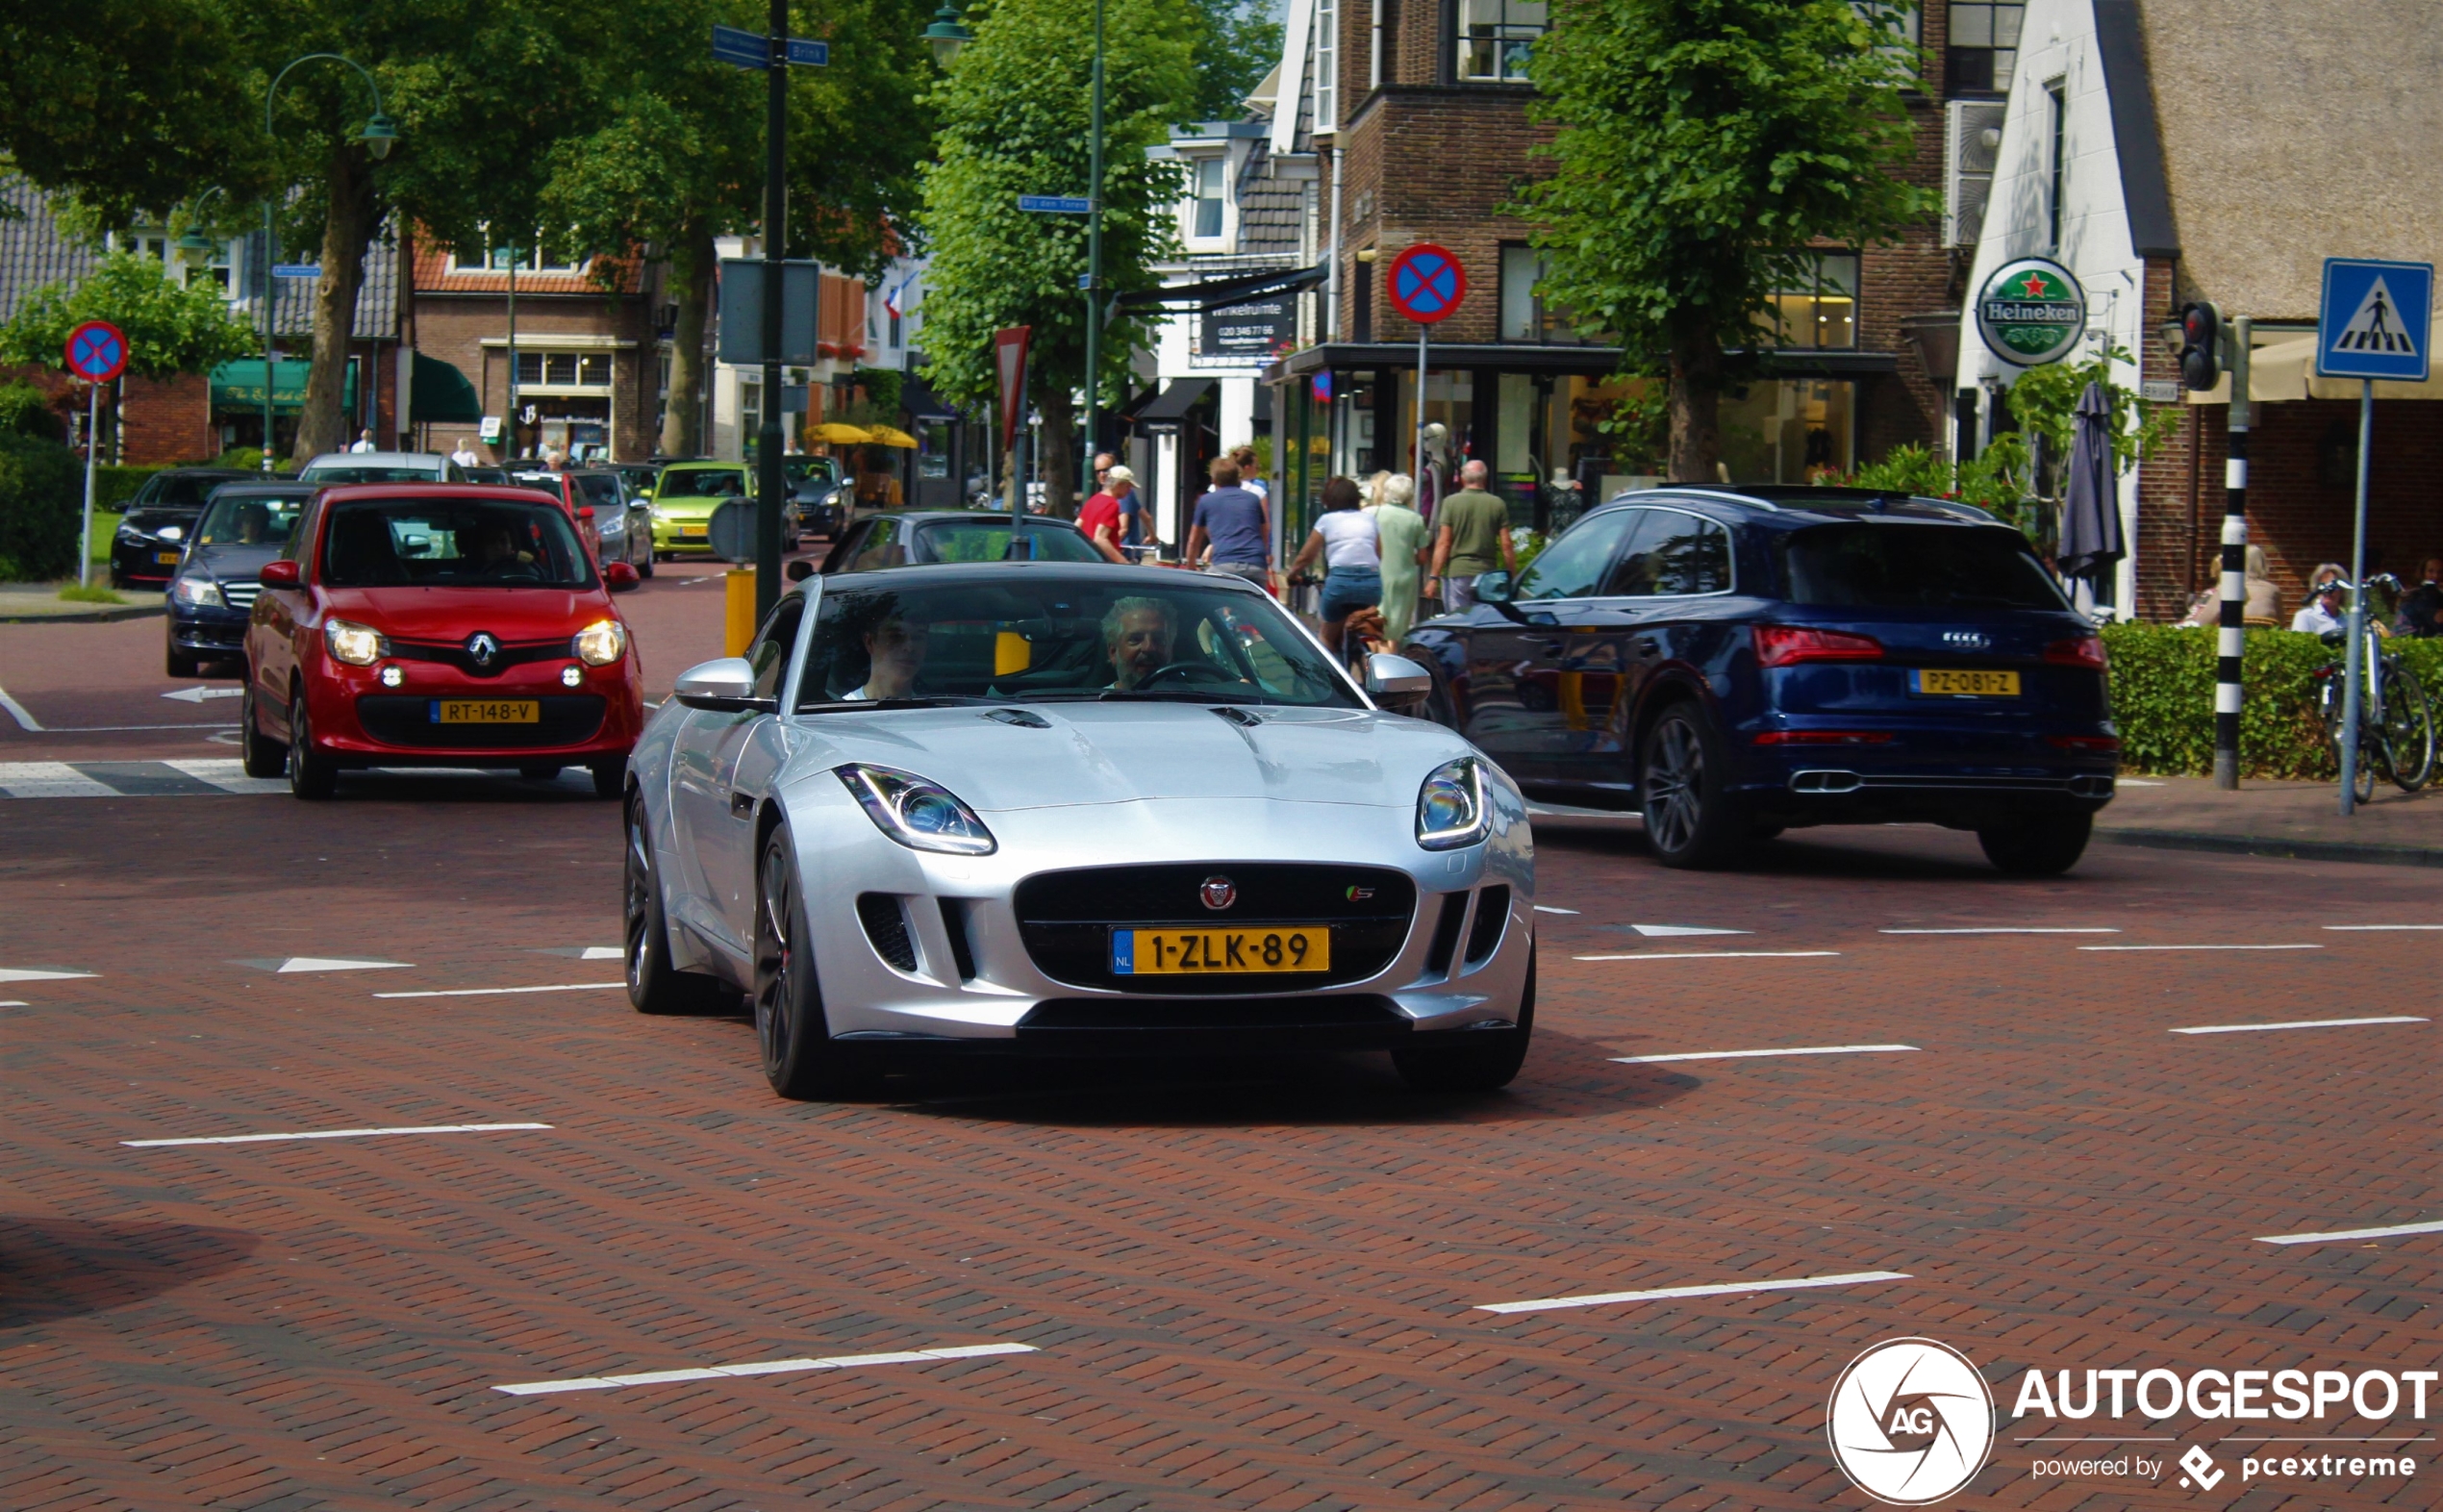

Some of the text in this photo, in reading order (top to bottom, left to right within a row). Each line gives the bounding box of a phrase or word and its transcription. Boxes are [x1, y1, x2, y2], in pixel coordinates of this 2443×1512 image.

[793, 45, 822, 60] Brink
[1987, 303, 2078, 320] Heineken
[1928, 672, 2009, 693] PZ-081-Z
[449, 704, 529, 720] RT-148-V
[1151, 934, 1308, 968] 1-ZLK-89
[1116, 957, 1130, 968] NL
